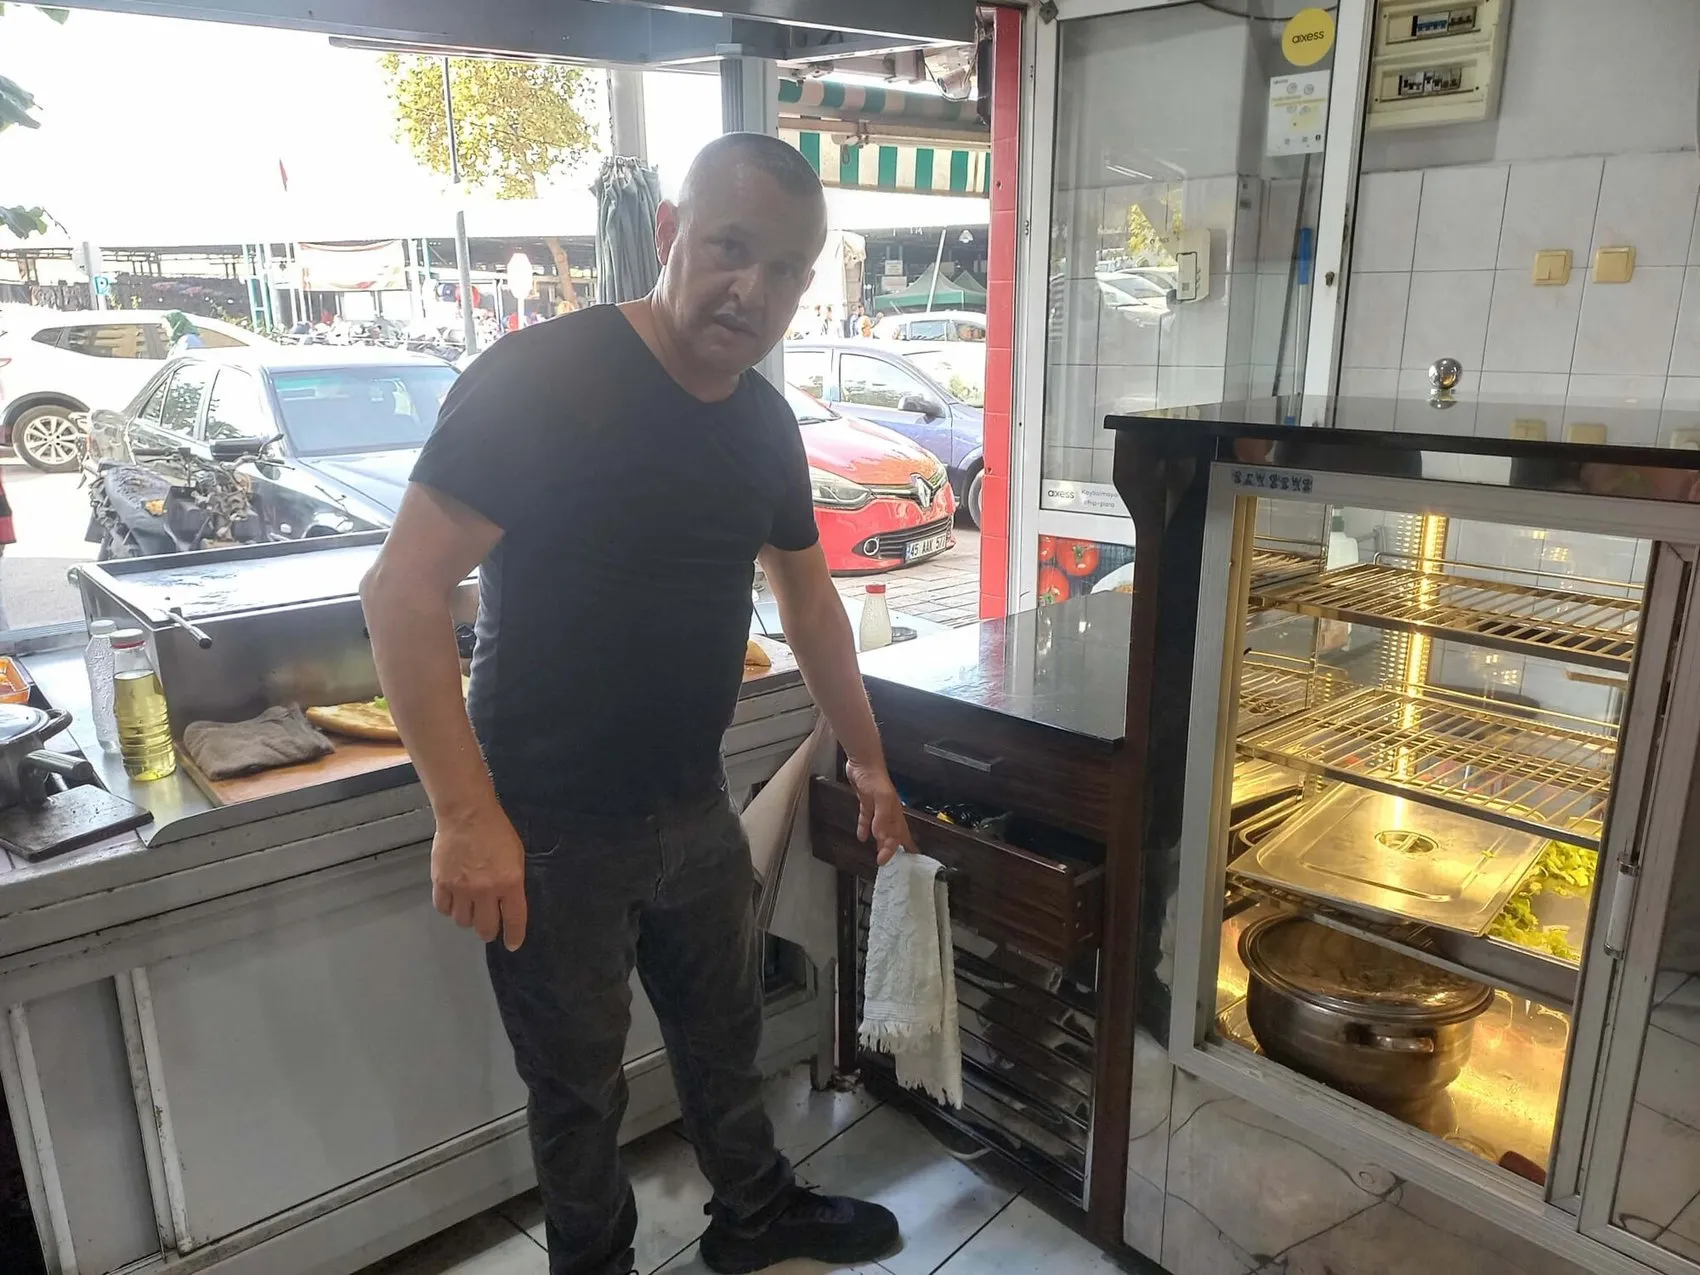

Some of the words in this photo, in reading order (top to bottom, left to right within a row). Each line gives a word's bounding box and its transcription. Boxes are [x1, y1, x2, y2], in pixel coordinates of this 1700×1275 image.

[1292, 31, 1325, 44] axess
[1047, 489, 1076, 499] axess
[910, 543, 919, 557] 45
